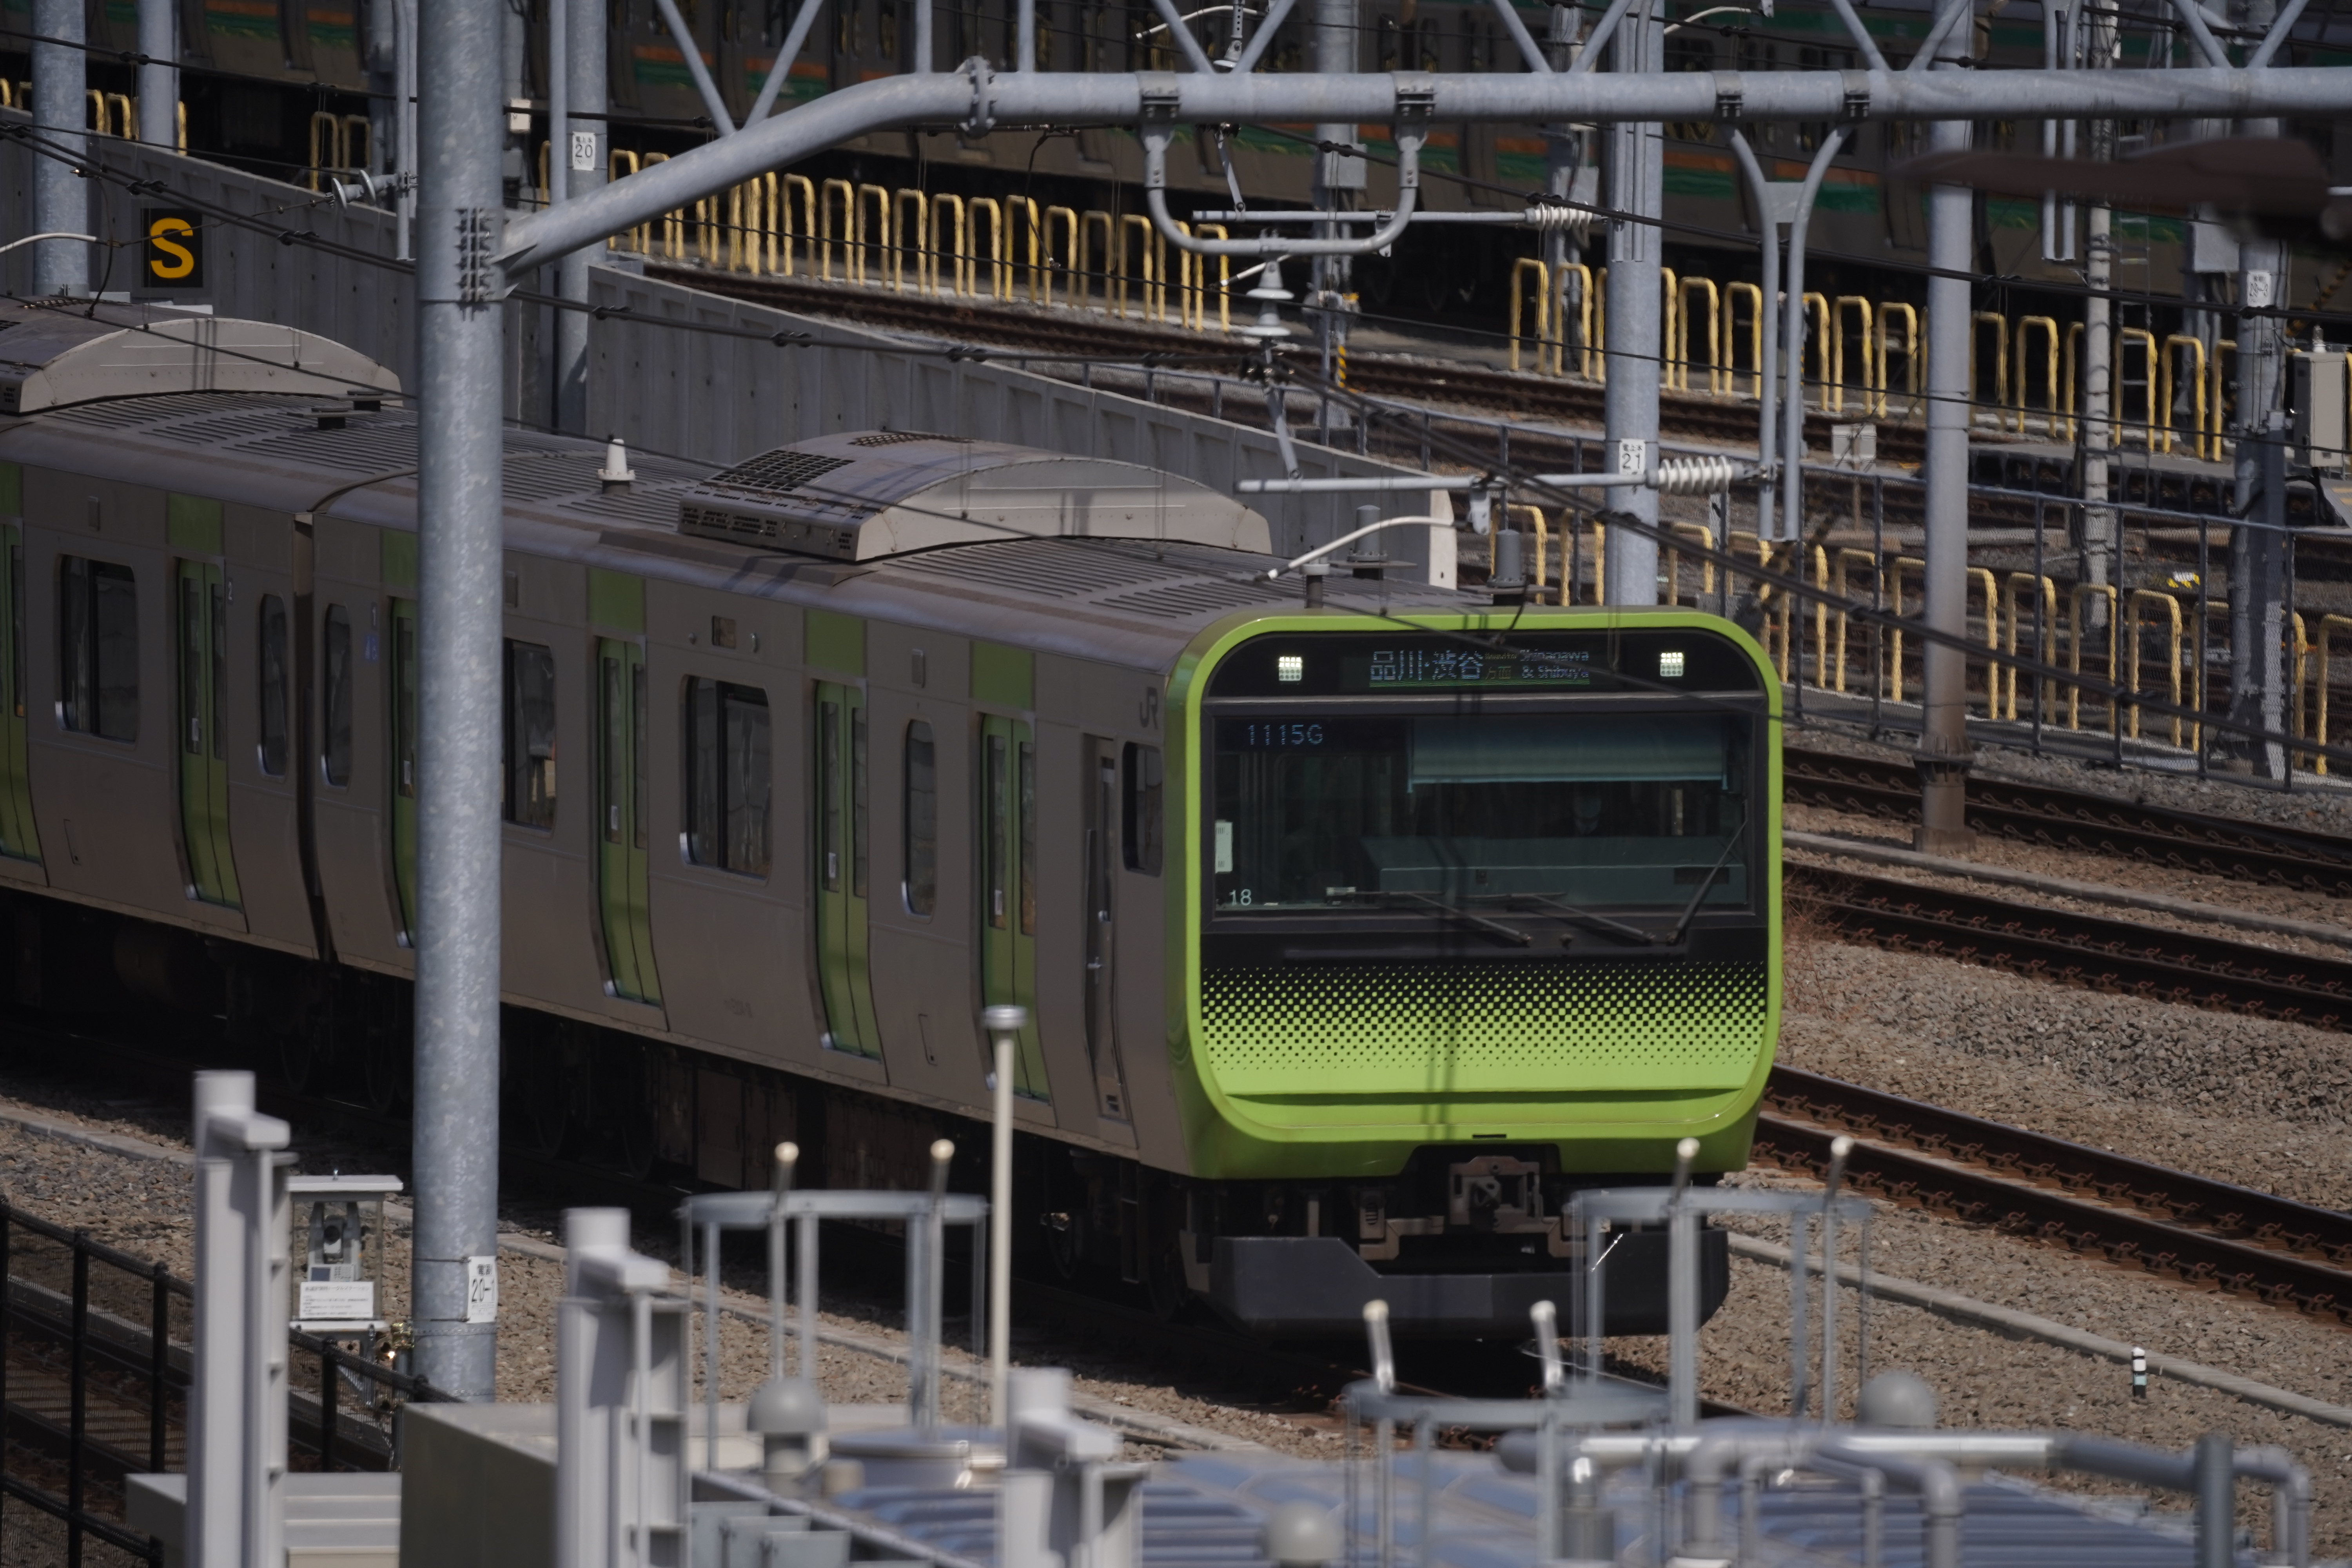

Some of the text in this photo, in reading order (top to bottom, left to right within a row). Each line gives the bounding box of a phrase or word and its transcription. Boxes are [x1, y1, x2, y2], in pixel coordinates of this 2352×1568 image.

[575, 143, 593, 157] 20
[151, 217, 195, 279] S
[1622, 453, 1640, 469] 21
[1521, 666, 1589, 681] & Shibuya
[1139, 686, 1159, 730] JR
[1248, 724, 1323, 745] 1115G
[1229, 889, 1252, 906] 18
[472, 1278, 495, 1302] 20-1
